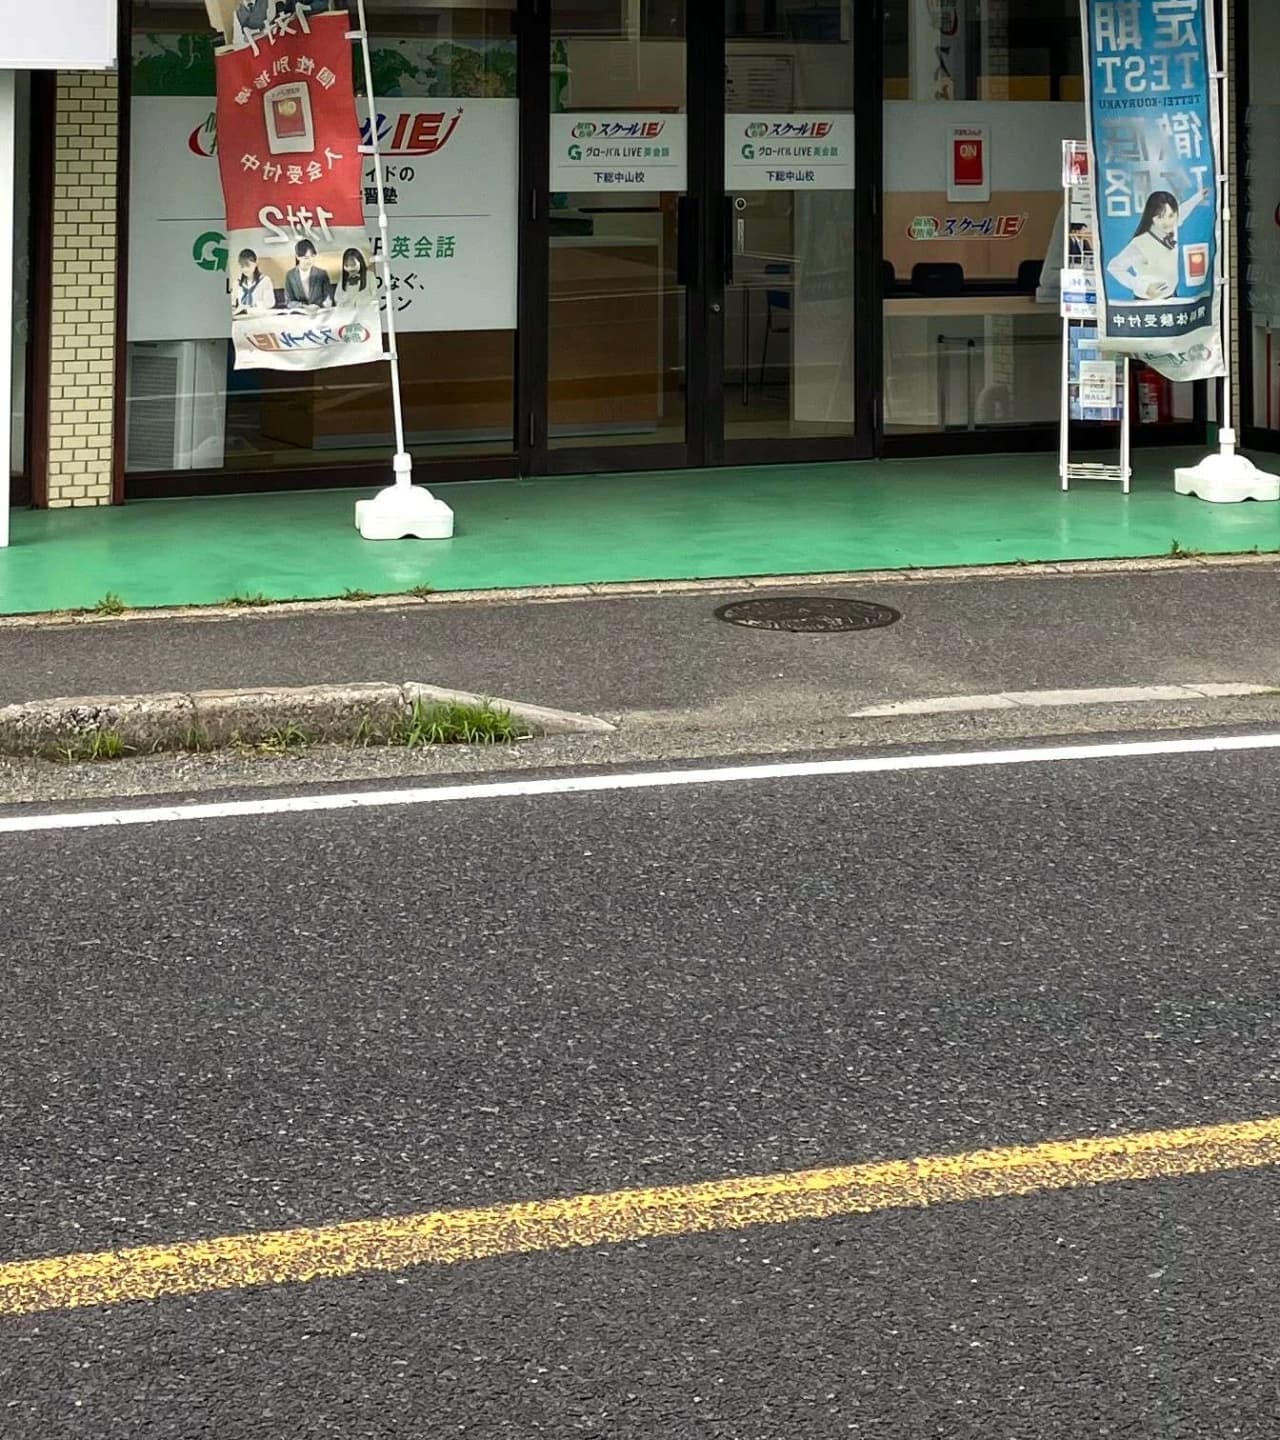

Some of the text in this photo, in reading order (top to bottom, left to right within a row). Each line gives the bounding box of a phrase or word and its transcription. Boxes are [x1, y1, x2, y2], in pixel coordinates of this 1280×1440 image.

[361, 113, 446, 149] ルIE
[597, 122, 660, 137] スクールIE
[769, 122, 829, 137] スクールIE
[623, 147, 642, 157] LIVE
[793, 146, 812, 157] LIVE
[959, 144, 978, 158] ON
[365, 166, 415, 182] イドの
[593, 171, 646, 184] 下総中山校
[766, 170, 816, 182] 下総中山校
[363, 187, 398, 205] 習塾
[943, 216, 1020, 236] スクールIE
[391, 236, 456, 259] 英会話
